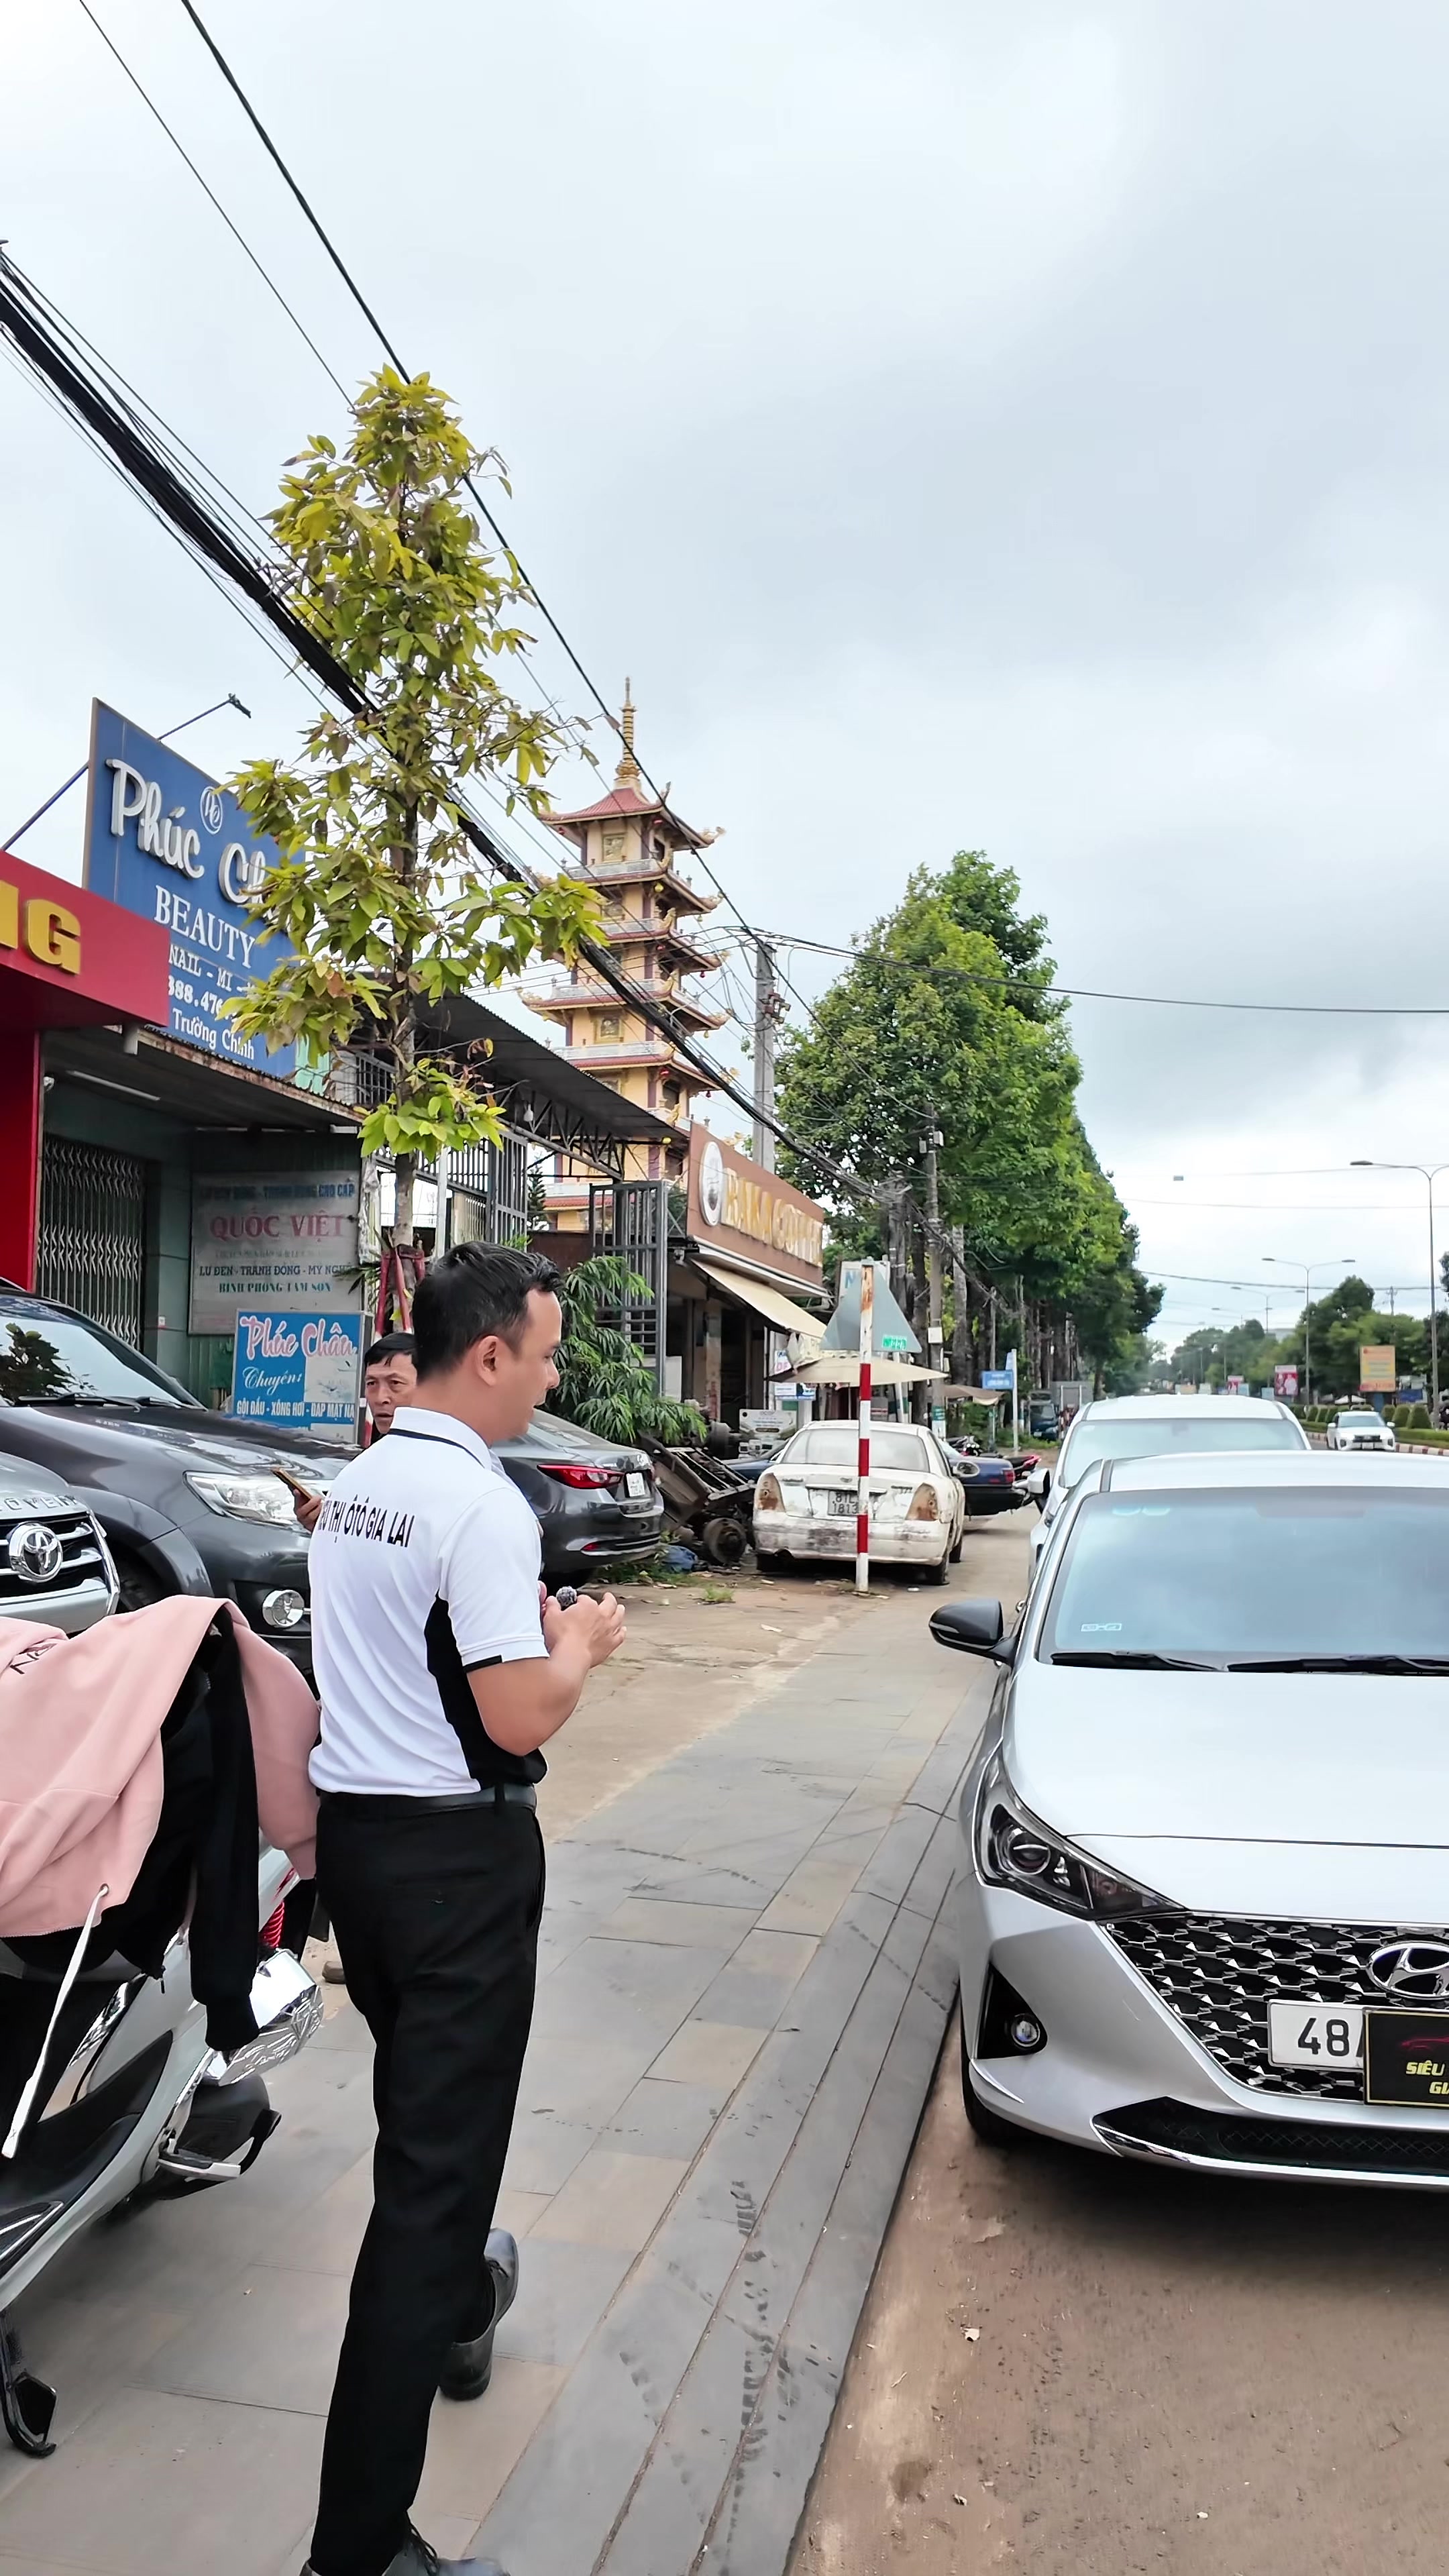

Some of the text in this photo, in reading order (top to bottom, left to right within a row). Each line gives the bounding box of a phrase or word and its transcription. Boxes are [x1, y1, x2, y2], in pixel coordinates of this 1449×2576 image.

[105, 758, 205, 878] Phúc
[154, 884, 256, 969] BEAUTY
[168, 944, 202, 978] NAIL
[172, 1008, 217, 1051] Trường
[210, 1205, 345, 1242] QUỐC VIỆT
[239, 1316, 299, 1360] Phúc
[386, 1511, 415, 1548] LAI
[1297, 2017, 1363, 2057] 48
[1405, 2059, 1446, 2076] SIÊU
[1429, 2082, 1449, 2094] GI
